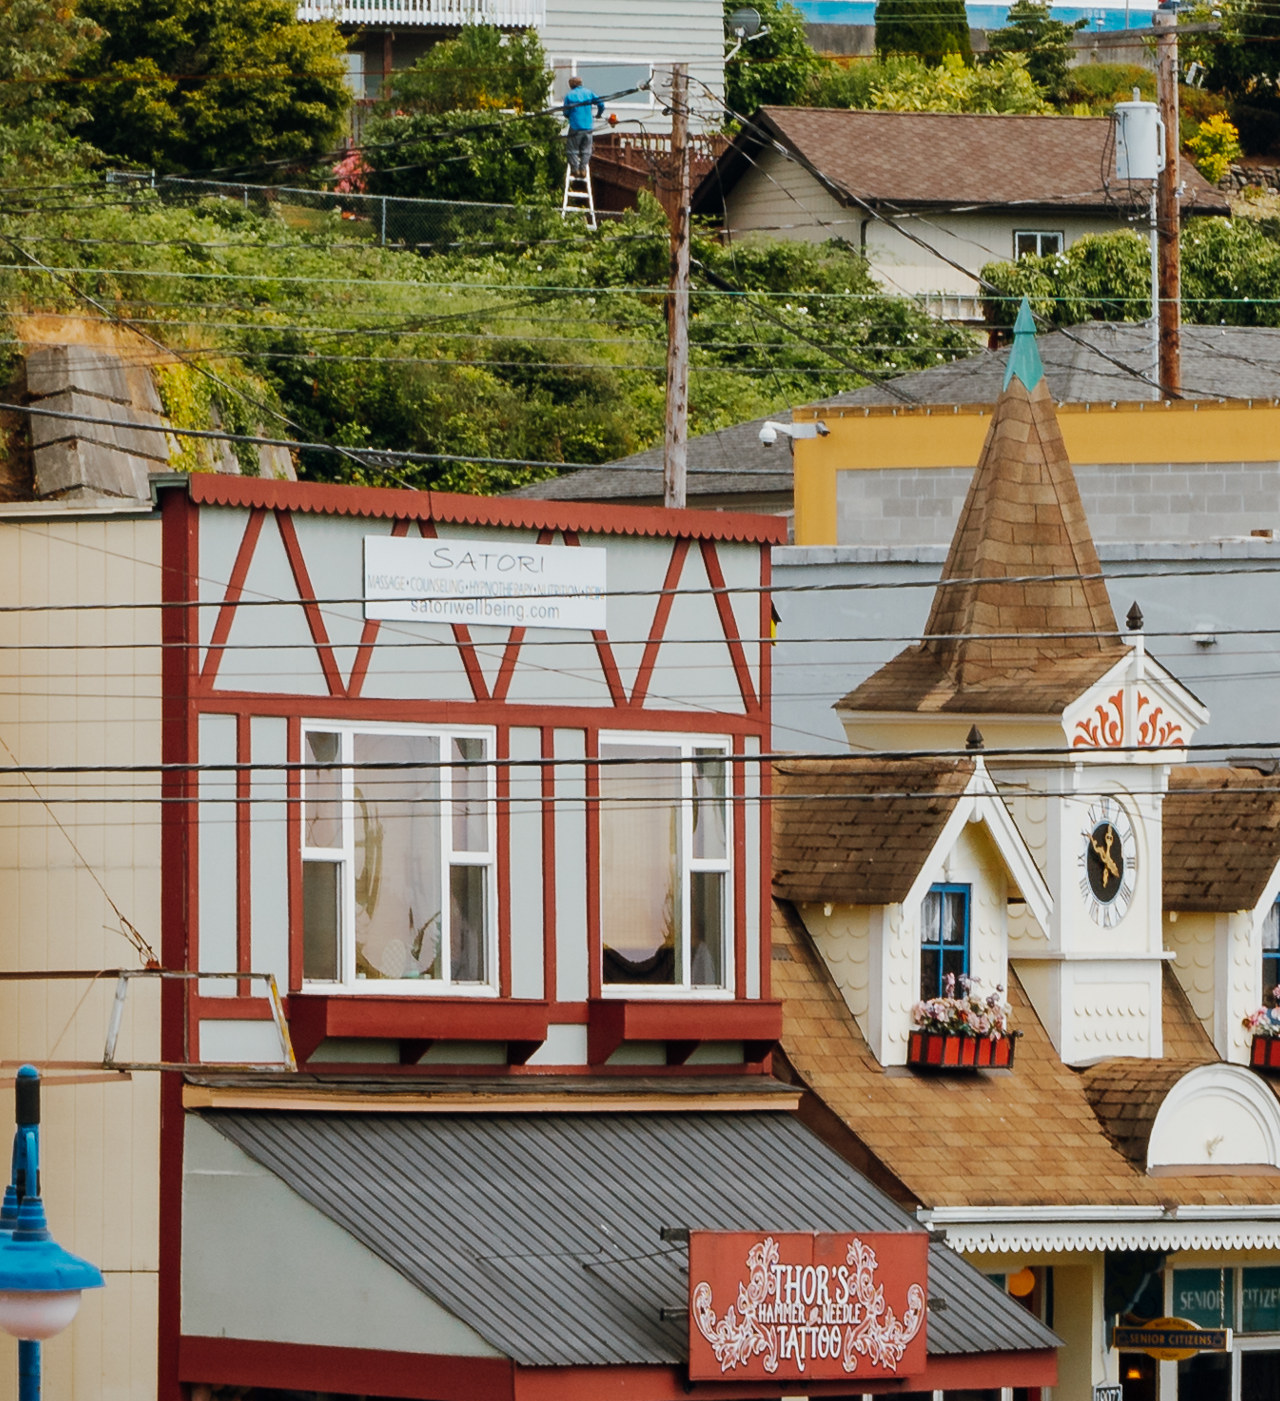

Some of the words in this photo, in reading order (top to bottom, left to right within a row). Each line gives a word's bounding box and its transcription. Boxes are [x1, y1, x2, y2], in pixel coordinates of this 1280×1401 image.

[429, 547, 544, 574] SATORI
[367, 574, 406, 591] MASSAGE
[410, 577, 465, 593] COUNSELING
[469, 580, 534, 597] HYPNOTHERAPY
[411, 597, 560, 622] satoriwellbeing.com
[770, 1264, 850, 1305] THOR'S
[758, 1303, 806, 1324] HAMMER
[820, 1303, 862, 1325] NEEDLE
[776, 1326, 842, 1372] TATTOO
[1129, 1333, 1165, 1346] SENIOR
[1168, 1333, 1212, 1346] CITIZENS
